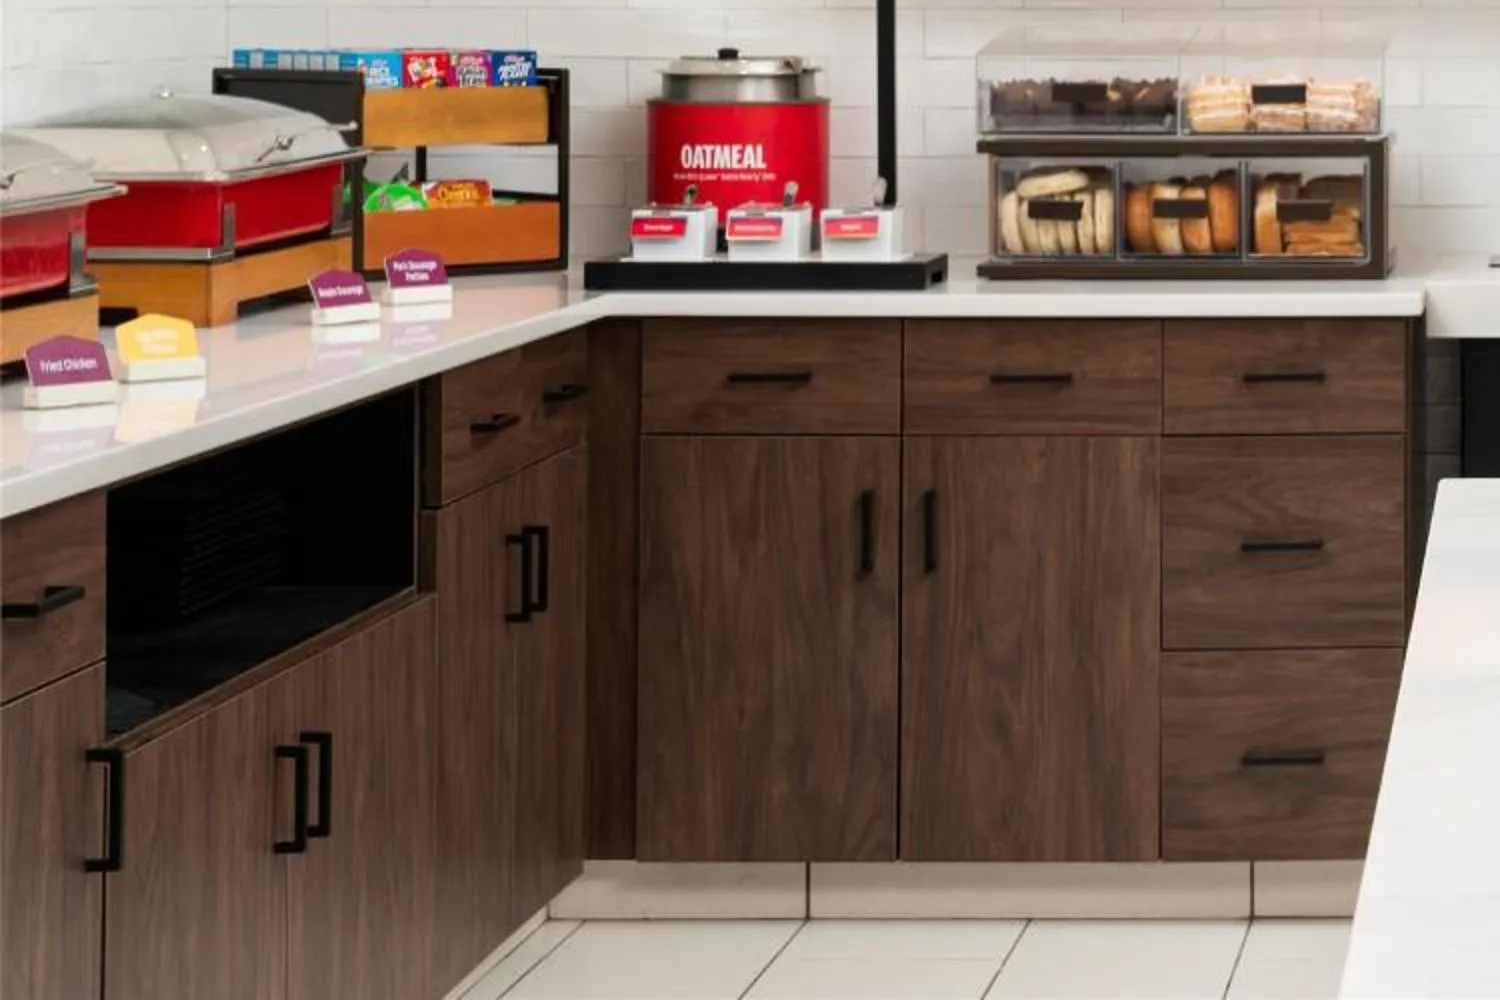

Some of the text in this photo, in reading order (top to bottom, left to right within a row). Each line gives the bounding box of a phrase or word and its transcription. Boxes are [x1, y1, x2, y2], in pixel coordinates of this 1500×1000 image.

[681, 143, 768, 170] OATMEAL
[40, 357, 98, 373] Fried Chicken
